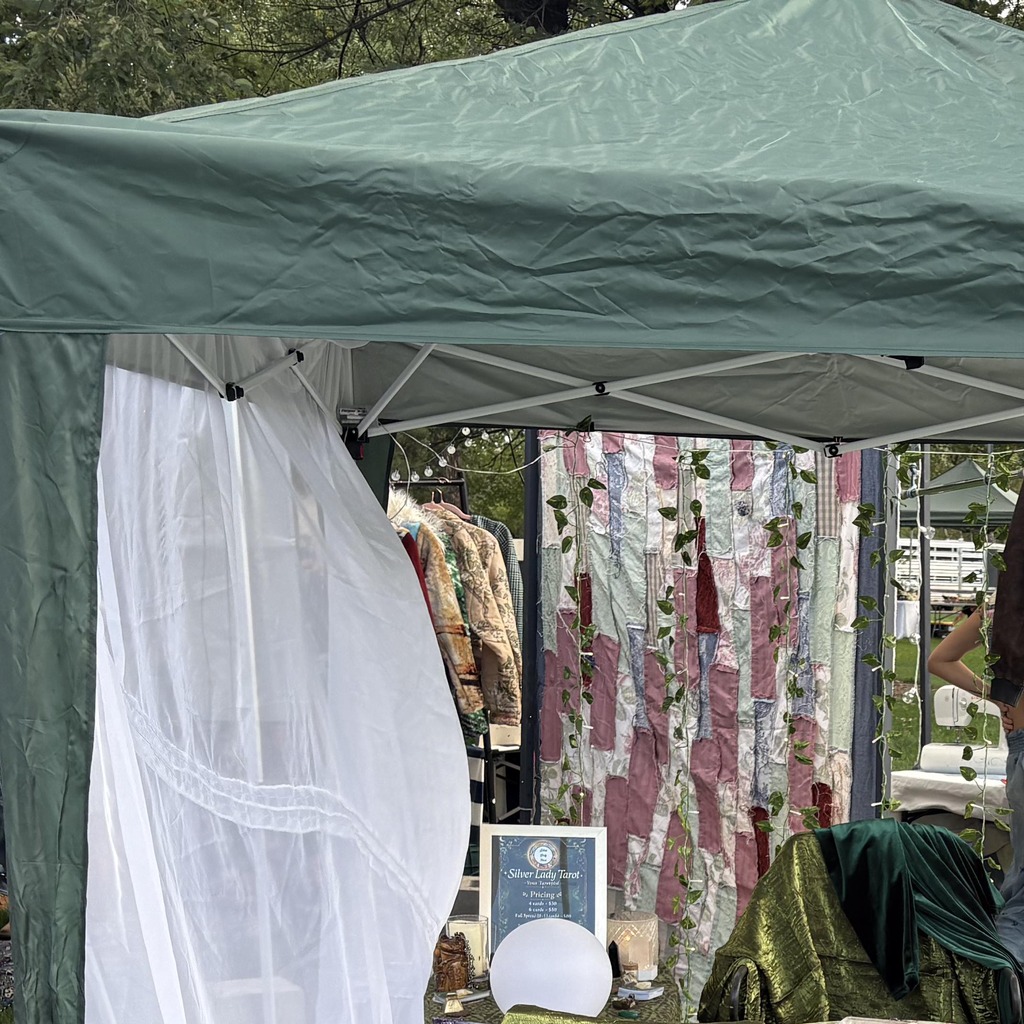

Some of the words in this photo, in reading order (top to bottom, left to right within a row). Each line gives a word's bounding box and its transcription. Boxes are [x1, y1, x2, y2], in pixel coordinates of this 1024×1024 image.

[507, 869, 534, 879] Silver
[535, 869, 557, 881] Lady
[557, 869, 580, 879] Tarot
[530, 890, 555, 899] Pricing
